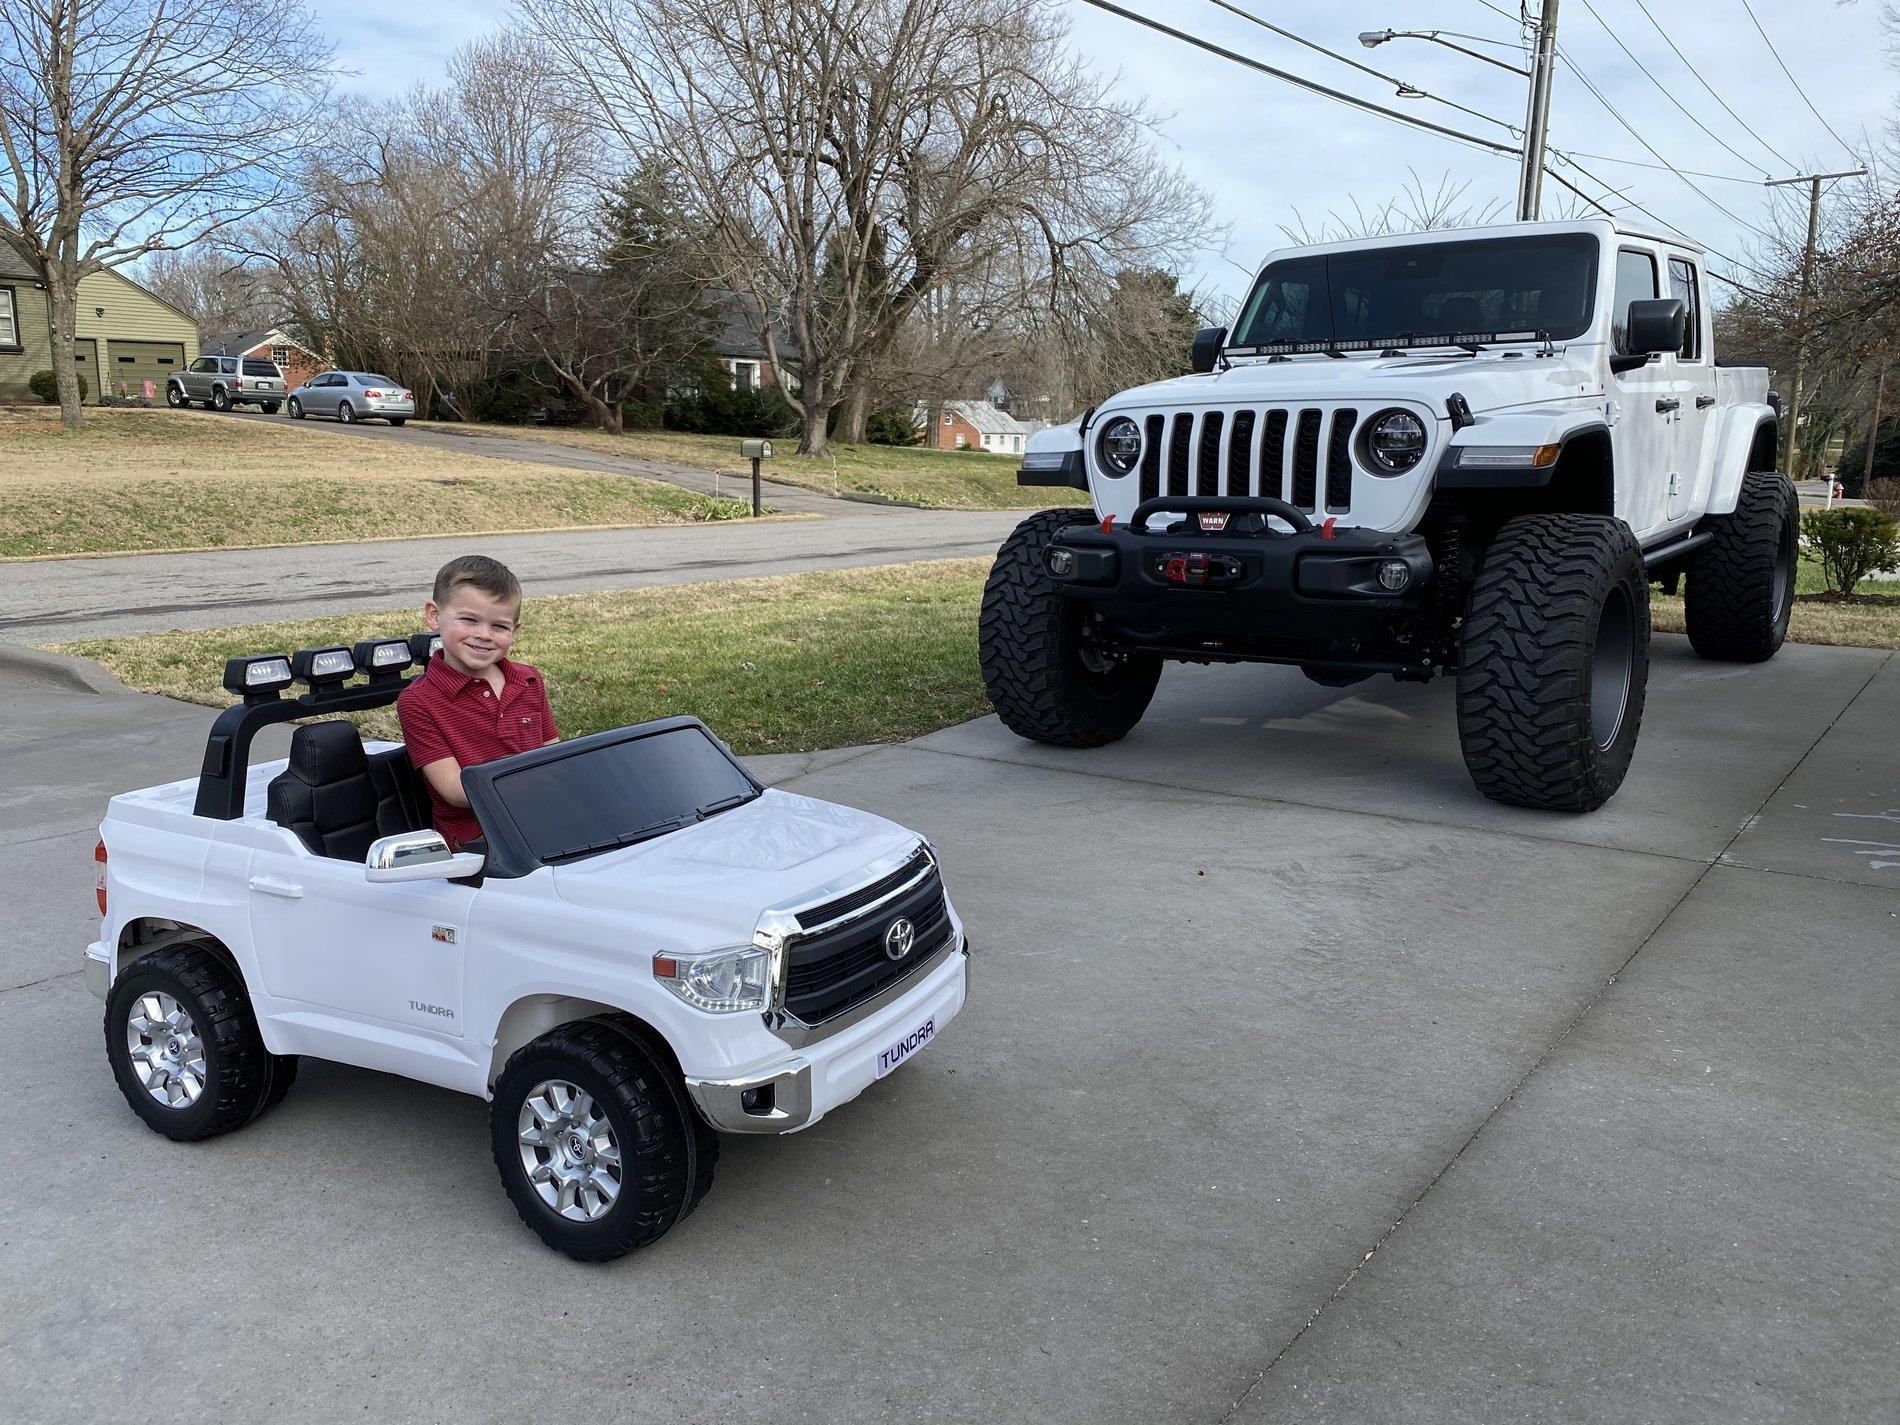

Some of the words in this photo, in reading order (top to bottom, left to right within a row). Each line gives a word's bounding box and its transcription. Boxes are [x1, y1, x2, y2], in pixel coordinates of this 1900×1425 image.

[1202, 517, 1224, 525] WARN
[408, 1000, 454, 1019] TUNDRA
[881, 1020, 933, 1069] TUNDRA
